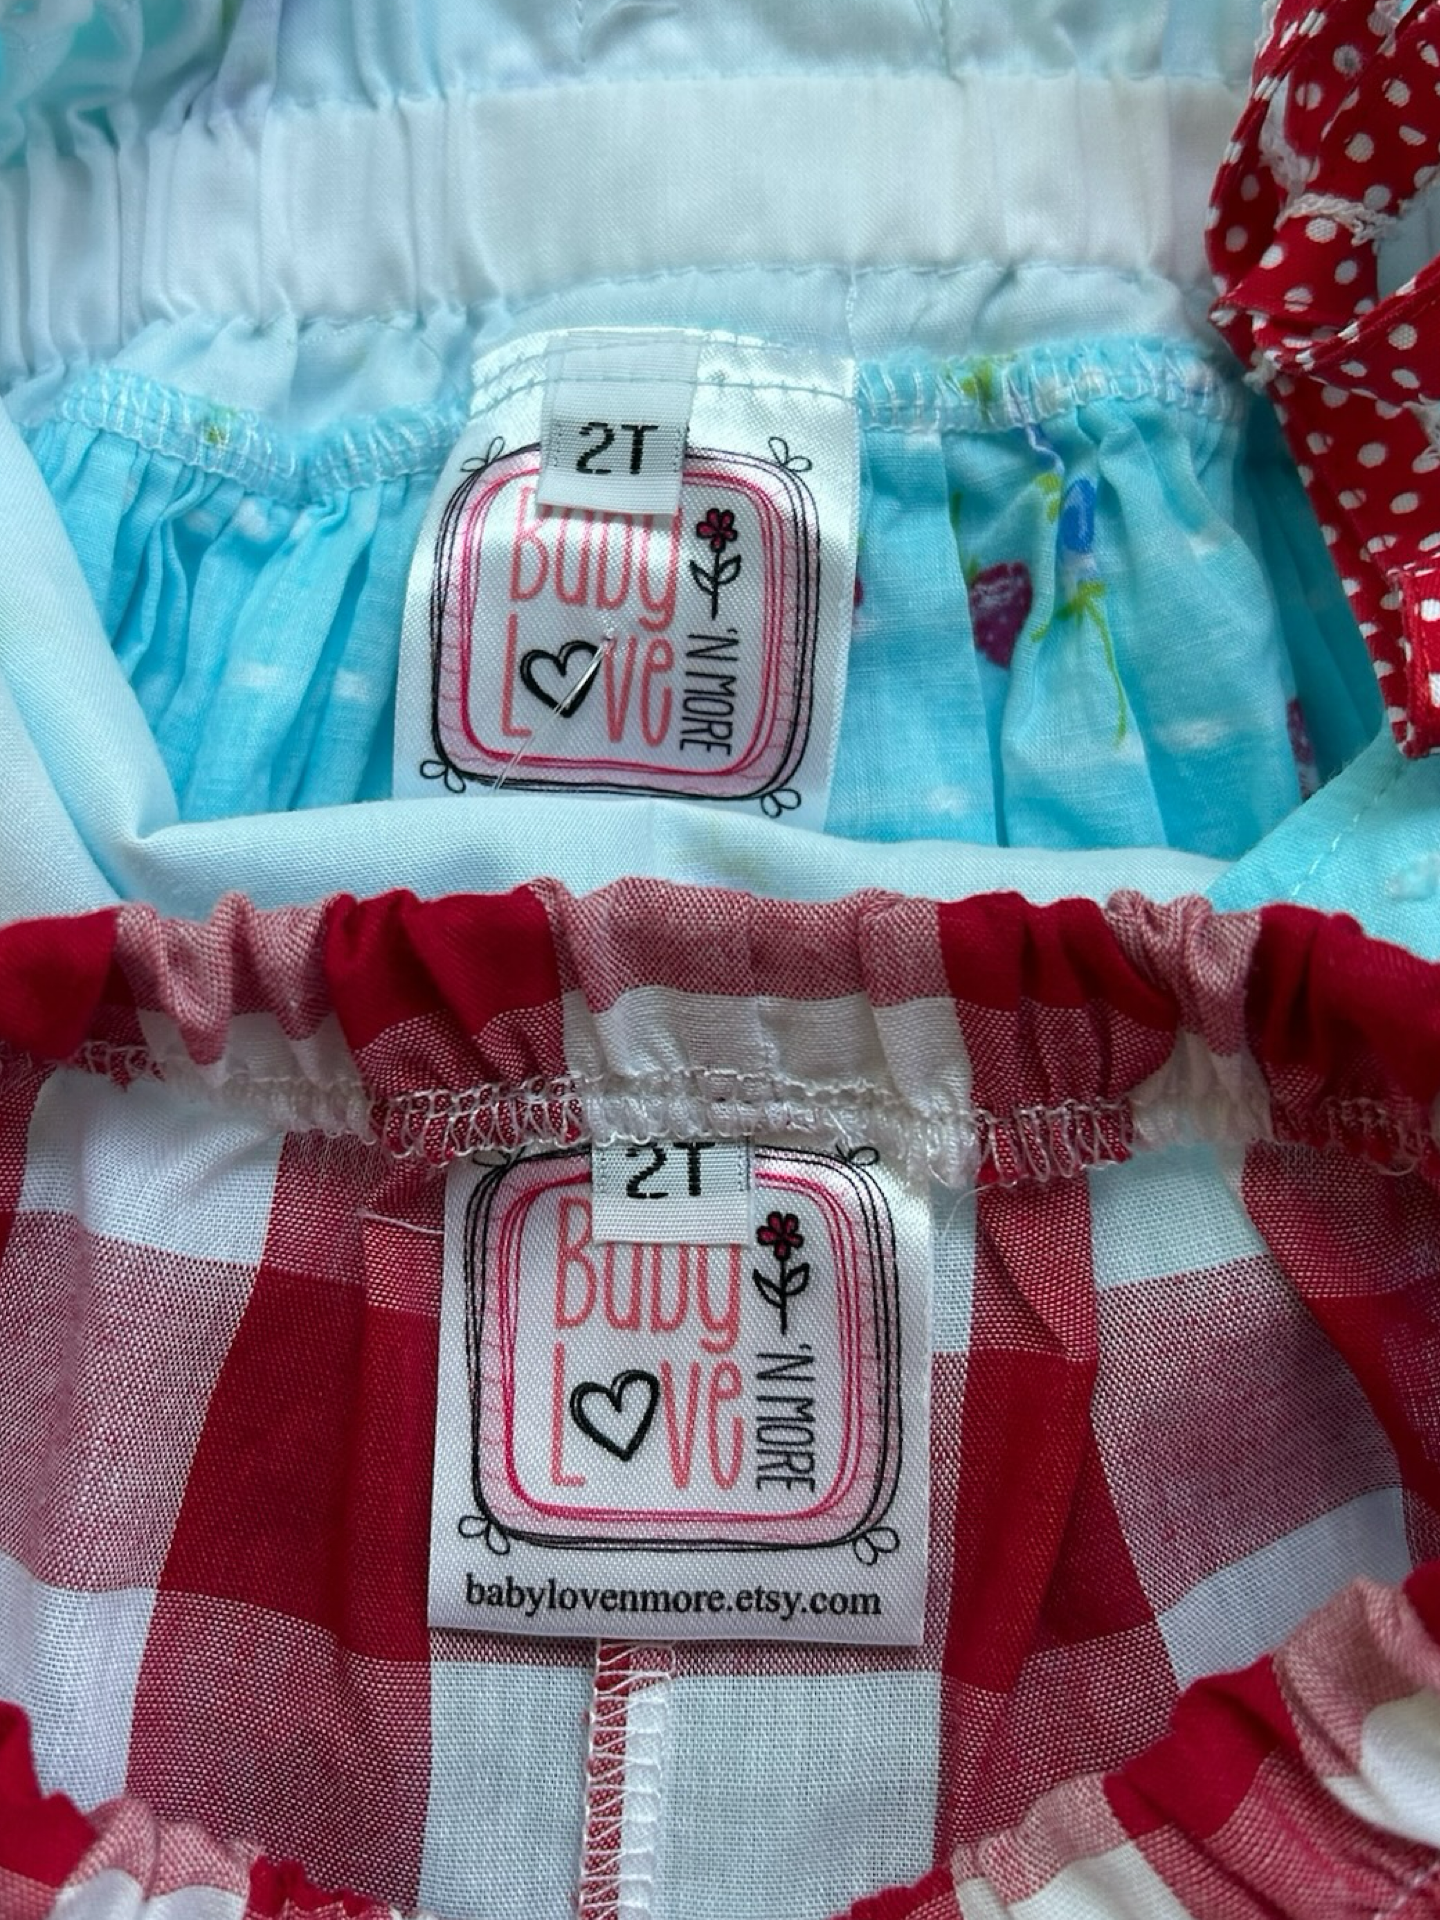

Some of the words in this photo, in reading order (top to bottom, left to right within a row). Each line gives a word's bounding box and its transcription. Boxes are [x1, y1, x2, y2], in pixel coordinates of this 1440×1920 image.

[575, 421, 659, 475] 2T
[679, 670, 737, 757] MORE
[625, 1141, 716, 1199] 2T
[756, 1395, 816, 1493] MORE
[465, 1573, 882, 1621] babylovenmore.etsy.com
